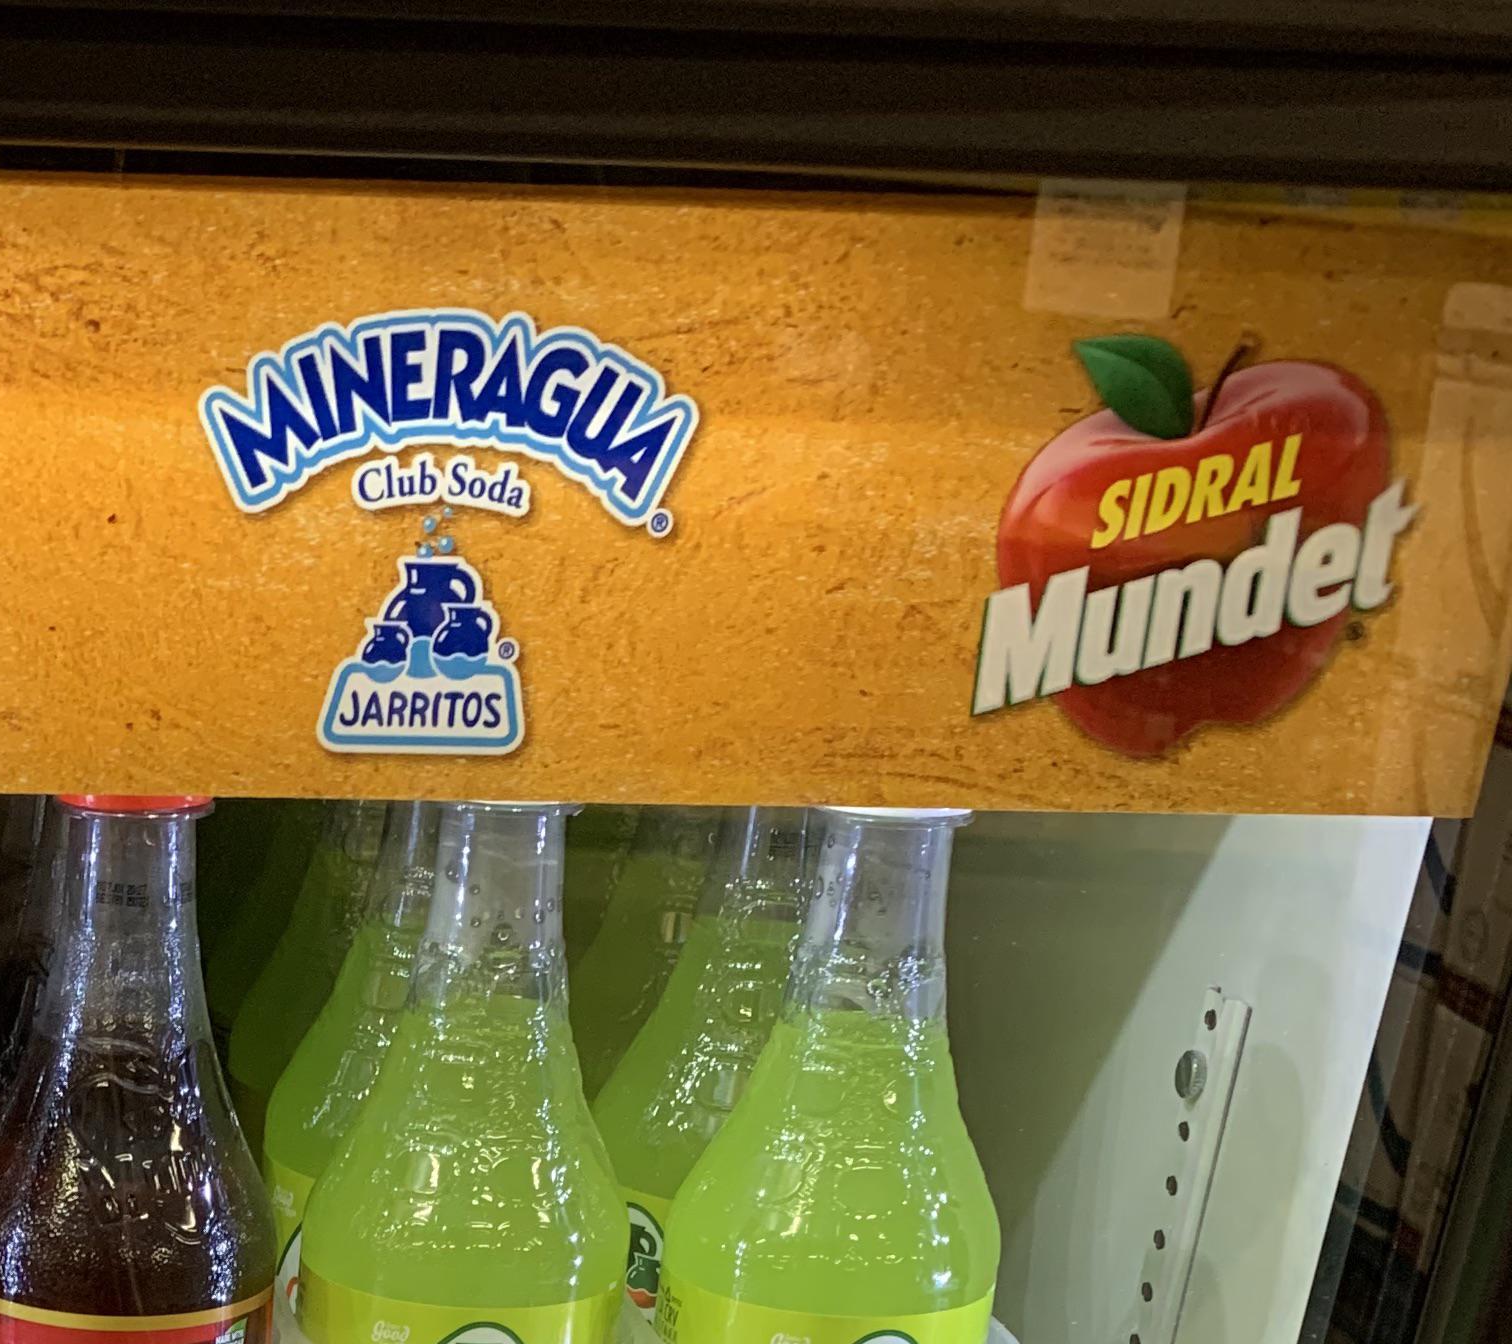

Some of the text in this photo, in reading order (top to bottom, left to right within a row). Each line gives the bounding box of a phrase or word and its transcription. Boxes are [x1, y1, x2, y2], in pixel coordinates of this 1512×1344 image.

[214, 324, 680, 506] MINERAGUA
[357, 461, 525, 509] Club Soda
[1090, 433, 1304, 550] SIDRAL
[970, 477, 1420, 717] Mundet
[340, 690, 502, 729] JARRITOS
